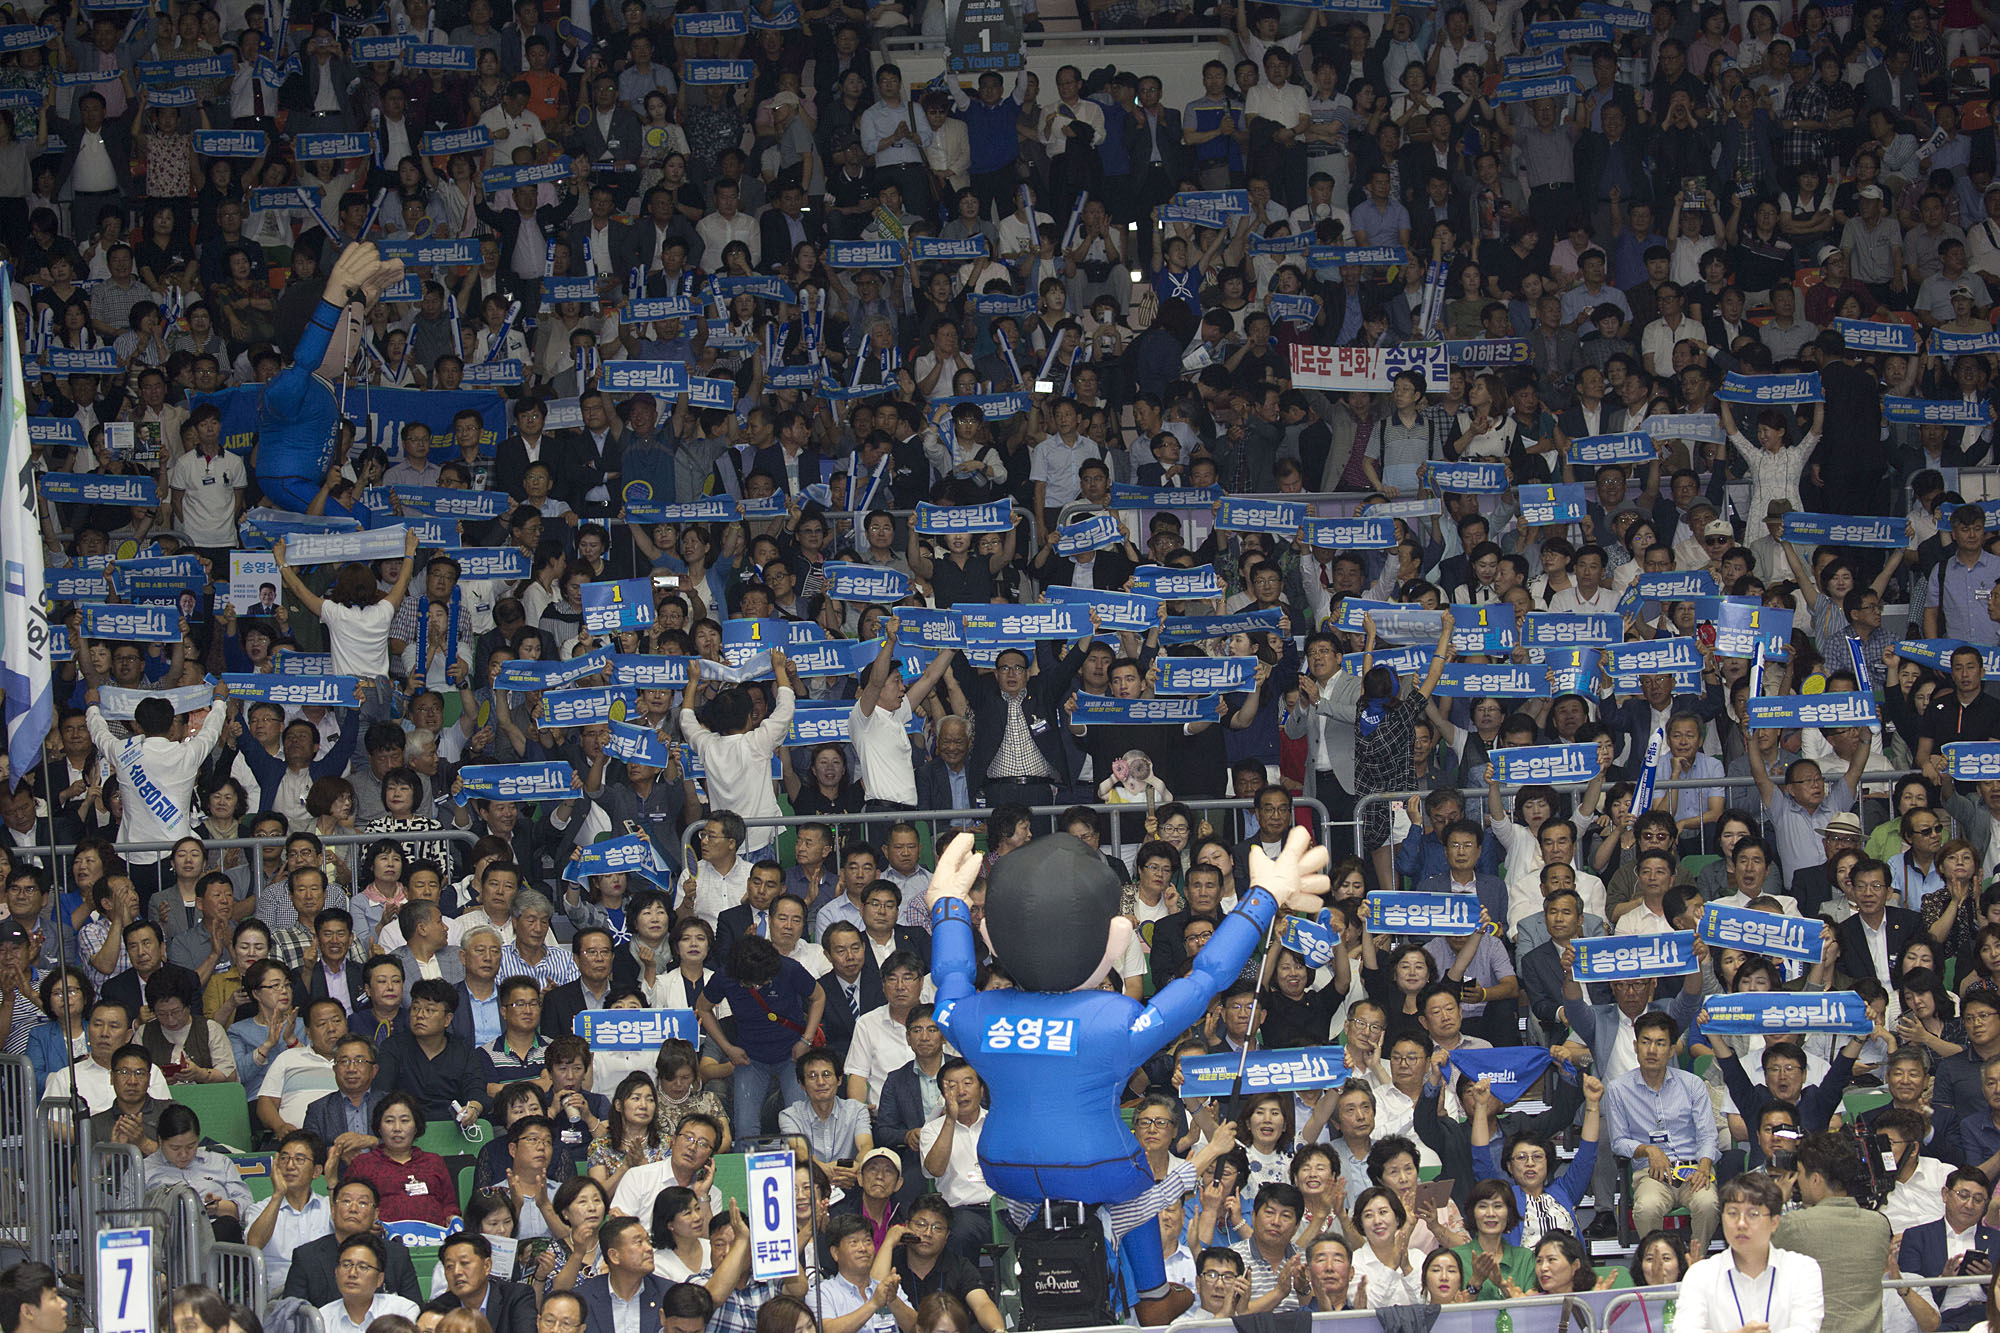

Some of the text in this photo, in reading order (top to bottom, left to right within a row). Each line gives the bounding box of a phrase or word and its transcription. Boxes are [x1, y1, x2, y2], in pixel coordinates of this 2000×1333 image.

[685, 15, 741, 34] 송영길
[1558, 19, 1608, 40] 송영길
[979, 28, 991, 53] 1
[174, 58, 225, 77] 송영길
[415, 46, 470, 67] 송영길
[965, 55, 1004, 70] Young
[694, 61, 747, 81] 송영길
[1522, 79, 1571, 99] 송영길
[203, 133, 260, 153] 송영길
[308, 135, 366, 155] 송영길
[431, 132, 490, 154] 송영길
[515, 162, 570, 183] 송영길
[418, 243, 473, 262] 송영길
[837, 245, 896, 262] 송영길
[924, 239, 985, 257] 송영길
[1345, 246, 1400, 263] 송영길
[634, 297, 697, 318] 송영길
[1844, 325, 1909, 348] 송영길
[52, 351, 114, 370] 송영길
[1338, 346, 1380, 381] 변화!
[1462, 342, 1529, 362] 이해찬 3
[612, 364, 679, 388] 송영길
[1756, 379, 1813, 400] 송영길
[1924, 400, 1984, 421] 송영길
[29, 420, 78, 441] 영길
[1581, 433, 1649, 460] 송영길
[84, 477, 147, 501] 송영길
[1436, 466, 1500, 489] 송영길
[1153, 488, 1217, 506] 송영길
[1547, 487, 1556, 501] 1
[435, 495, 498, 518] 송영길
[665, 500, 729, 519] 송영길
[930, 504, 1004, 529] 송영길
[1232, 504, 1298, 529] 송영길
[1058, 516, 1123, 551] 송영길
[1317, 520, 1389, 545] 송영길
[1830, 520, 1896, 543] 송영길
[232, 559, 278, 576] 1 송영길
[612, 585, 622, 603] 1
[837, 572, 905, 598] 송영길
[1155, 571, 1222, 594] 송영길
[1640, 575, 1706, 597] 송영길
[96, 609, 172, 636] 송영길
[1002, 608, 1078, 634] 송영길
[1478, 608, 1488, 626] 1
[1751, 611, 1760, 629] 1
[751, 622, 761, 640] 1
[1537, 616, 1613, 642] 송영길
[794, 646, 846, 671] 영길
[1571, 650, 1580, 667] 1
[1618, 643, 1697, 670] 송영길
[618, 659, 689, 684] 송영길
[1173, 660, 1246, 688] 송영길
[1464, 668, 1536, 693] 송영길
[269, 679, 344, 704] 송영길
[1129, 697, 1204, 720] 송영길
[1798, 696, 1877, 722] 송영길
[1509, 748, 1592, 780] 송영길
[1959, 753, 2000, 775] 송영
[129, 763, 179, 823] 송영길
[498, 768, 571, 795] 송영길
[1385, 897, 1476, 928] 송영길
[1298, 929, 1336, 964] 송영
[1719, 918, 1810, 955] 송영길
[1592, 938, 1687, 973] 송영길
[1762, 998, 1853, 1027] 송영길
[595, 1012, 687, 1044] 송영길
[987, 1017, 1075, 1052] 송영길
[1246, 1053, 1338, 1086] 송영길
[1478, 1069, 1518, 1084] 송영길
[762, 1175, 780, 1232] 6
[756, 1239, 792, 1264] 투표구
[117, 1258, 133, 1319] 7
